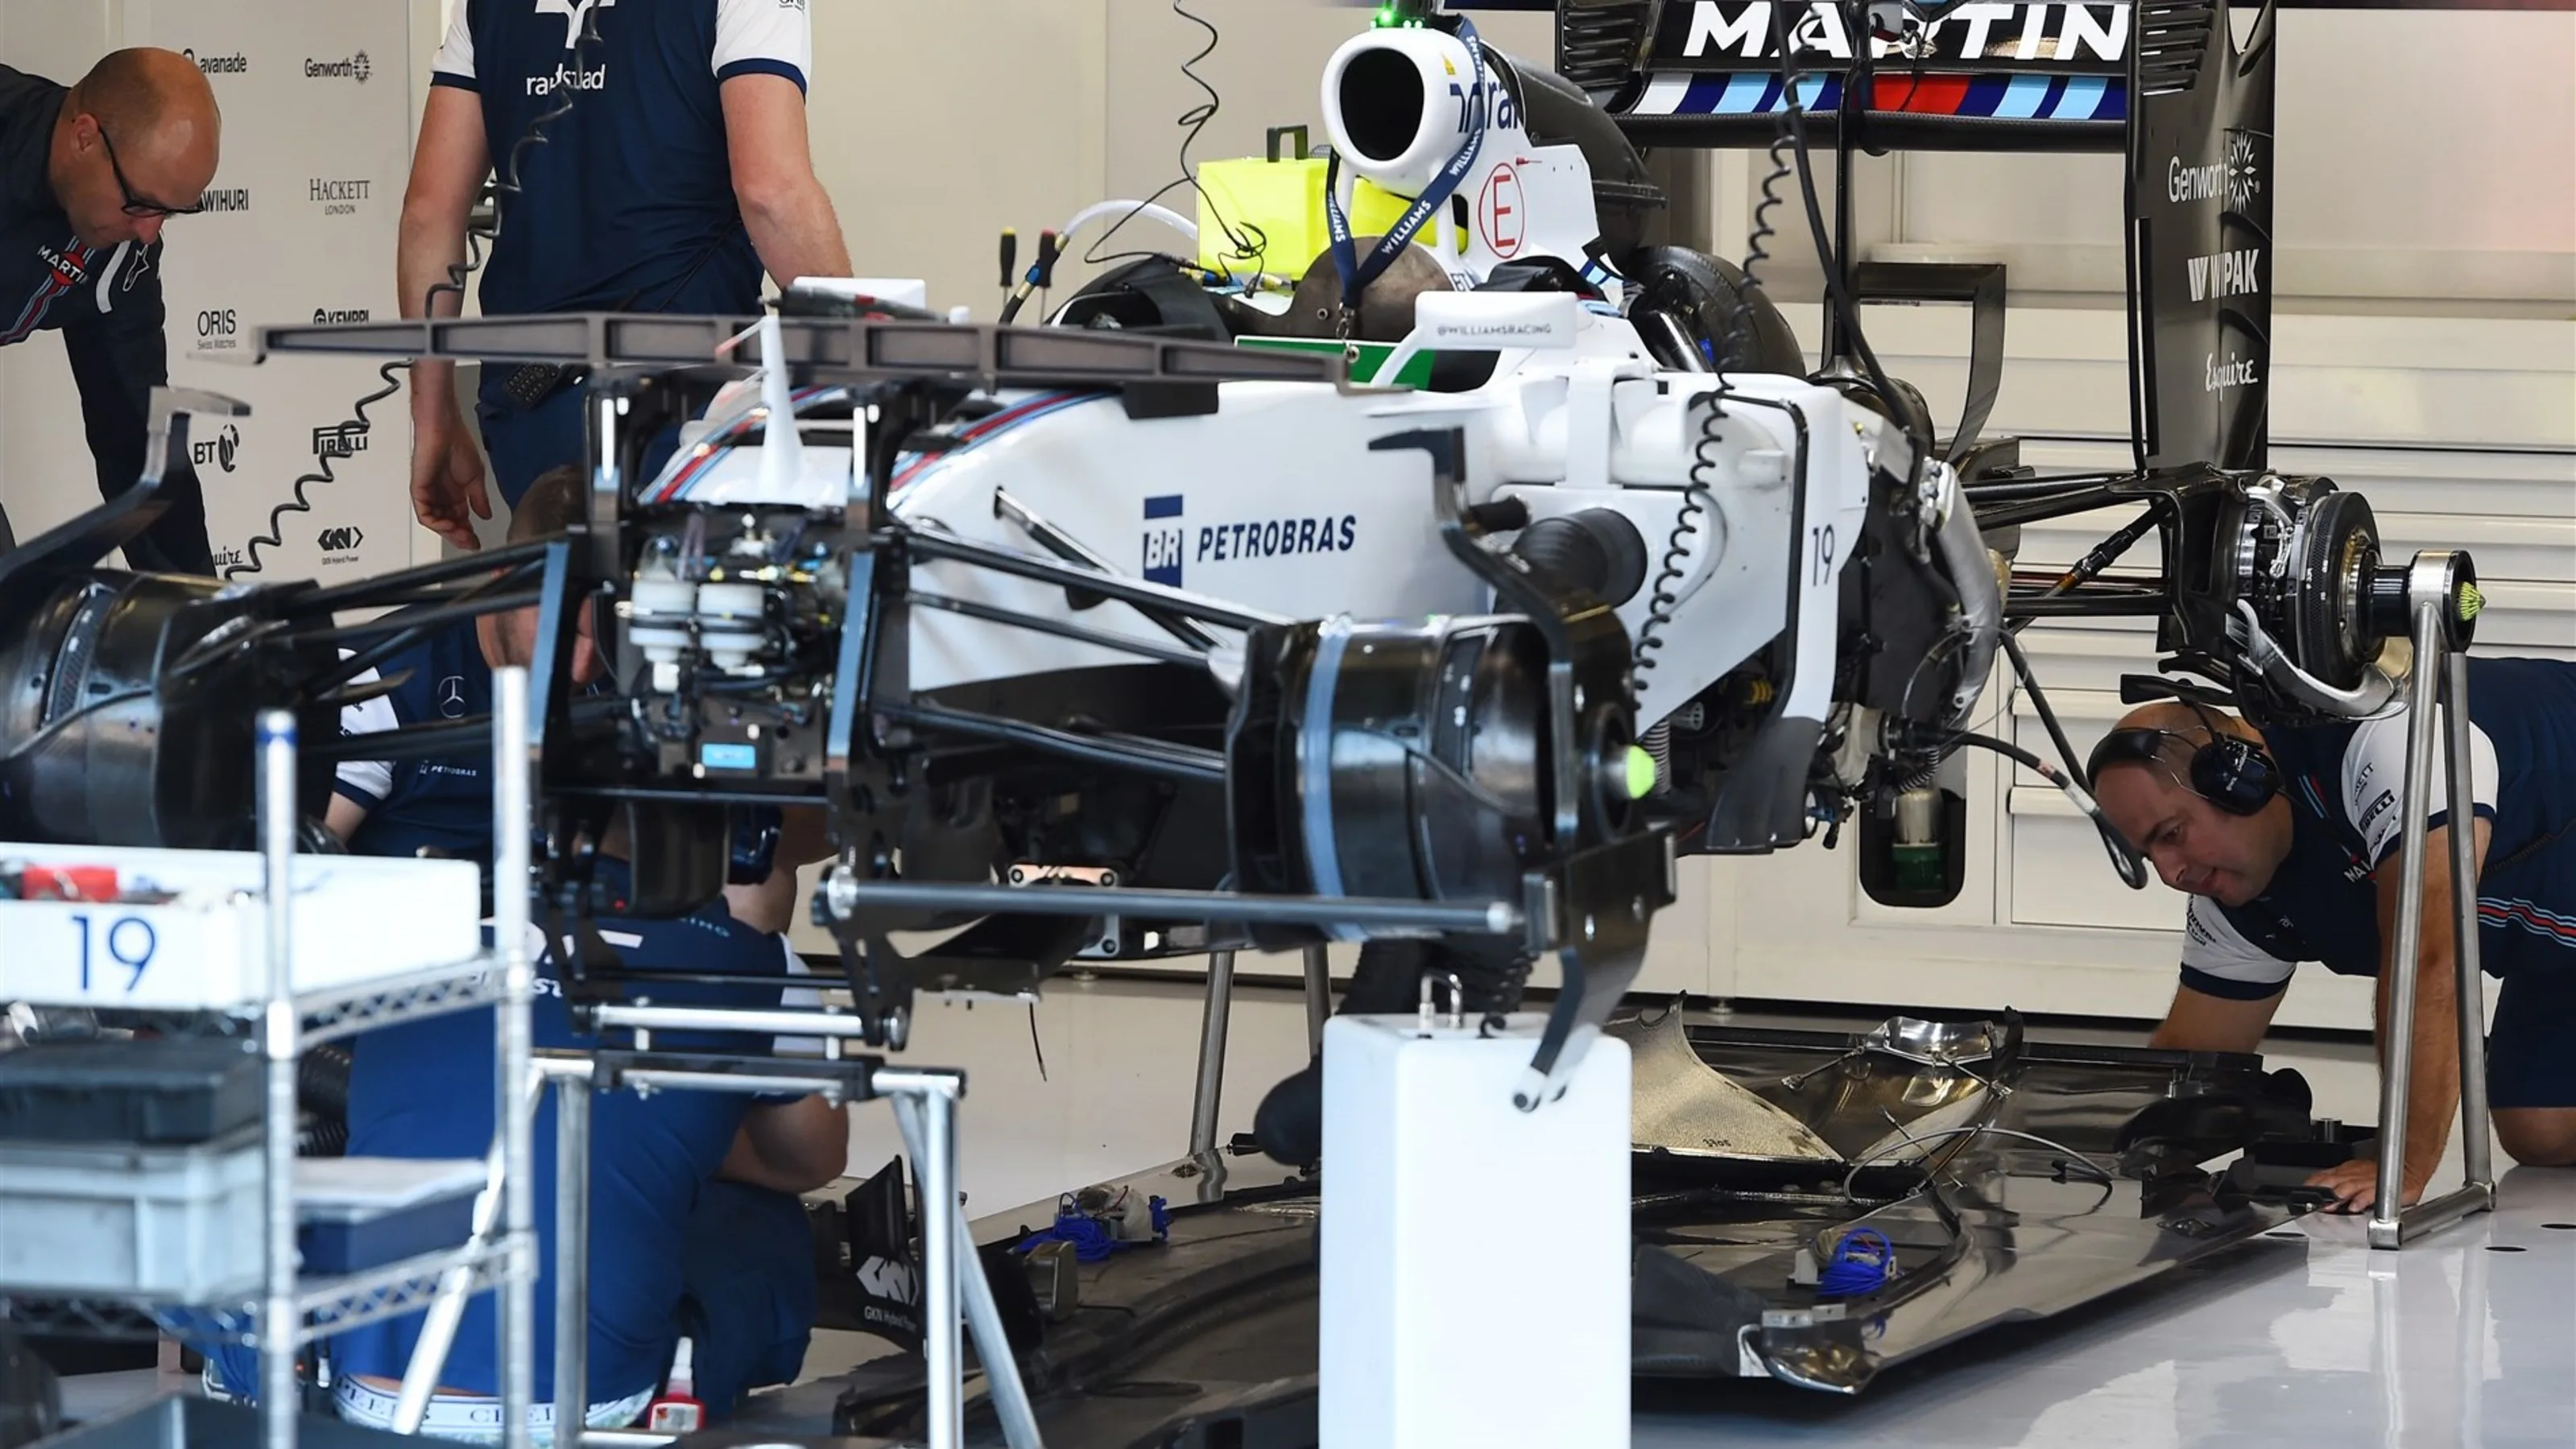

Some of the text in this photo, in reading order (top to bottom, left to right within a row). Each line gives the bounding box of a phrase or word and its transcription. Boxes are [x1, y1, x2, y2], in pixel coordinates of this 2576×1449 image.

[200, 52, 247, 73] avanade
[305, 57, 353, 77] Genworth
[309, 178, 370, 200] HACKETT
[2169, 156, 2228, 202] Genworth
[203, 188, 249, 212] WIHURI
[325, 204, 355, 215] LONDON
[1493, 175, 1515, 248] E
[1381, 200, 1432, 255] WILLIAMS
[197, 309, 236, 336] ORIS
[2206, 352, 2259, 402] Esquire
[194, 441, 217, 464] BT
[1197, 514, 1358, 563] PETROBRAS
[1812, 524, 1835, 587] 19
[72, 915, 156, 991] 19
